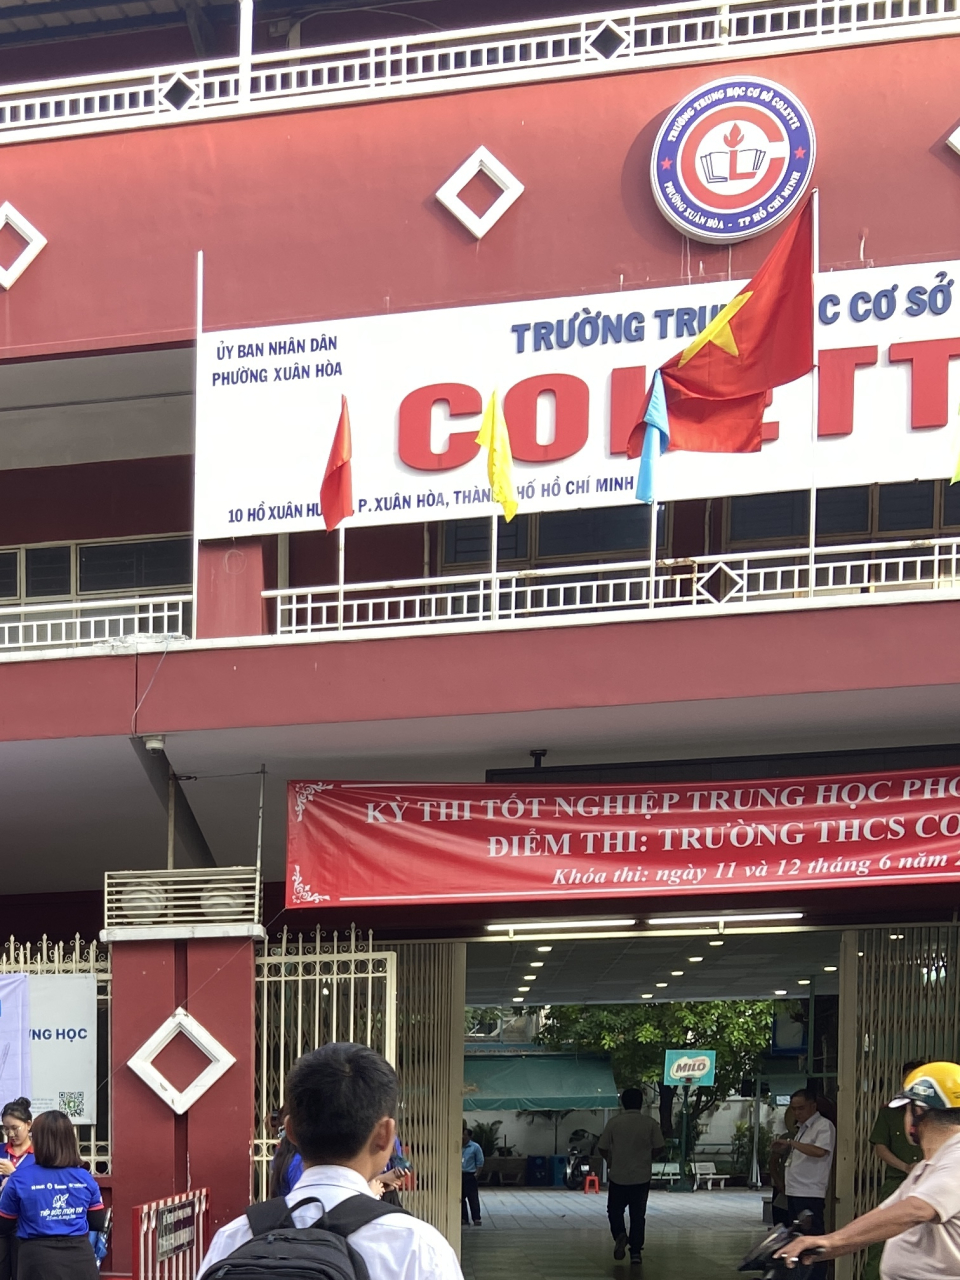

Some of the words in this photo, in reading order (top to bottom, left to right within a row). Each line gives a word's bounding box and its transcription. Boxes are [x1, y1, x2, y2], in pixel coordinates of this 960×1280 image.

[693, 89, 725, 111] TRUNG
[727, 86, 746, 98] HỌC
[772, 98, 801, 130] COLETTE
[738, 218, 751, 227] TP
[781, 170, 801, 198] MINH
[512, 307, 645, 353] TRƯỜNG
[849, 284, 899, 322] CƠ
[905, 270, 955, 316] SỞ
[216, 340, 234, 361] ỦY
[238, 343, 264, 359] BAN
[269, 337, 306, 356] NHÂN
[310, 334, 337, 352] DÂN
[212, 366, 268, 386] PHƯỜNG
[273, 362, 310, 382] XUÂN
[315, 359, 342, 378] HÒA
[228, 509, 243, 523] 10
[247, 502, 266, 521] HỒ
[268, 502, 303, 520] XUÂN
[416, 487, 450, 509] HÒA,
[453, 485, 494, 505] THÀN
[517, 478, 536, 500] HỐ
[540, 476, 561, 497] HỒ
[565, 475, 590, 495] CHÍ
[596, 475, 635, 493] MINH
[365, 796, 410, 824] KỲ
[417, 800, 472, 822] THI
[480, 792, 546, 820] TỐT
[553, 789, 680, 820] NGHIỆP
[687, 785, 805, 813] TRUNG
[816, 780, 892, 810] HỌC
[487, 828, 572, 858] ĐIỂM
[580, 830, 648, 855] THI:
[658, 819, 805, 851] TRƯỜNG
[814, 816, 905, 843] THCS
[552, 867, 607, 885] Khóa
[612, 866, 649, 883] thi:
[655, 864, 707, 885] ngày
[713, 862, 737, 880] 11
[744, 860, 768, 877] và
[778, 858, 800, 875] 12
[808, 855, 871, 876] tháng
[879, 853, 891, 870] 6
[898, 851, 947, 869] năm
[56, 1028, 88, 1043] HỌC
[675, 1060, 707, 1073] MILO
